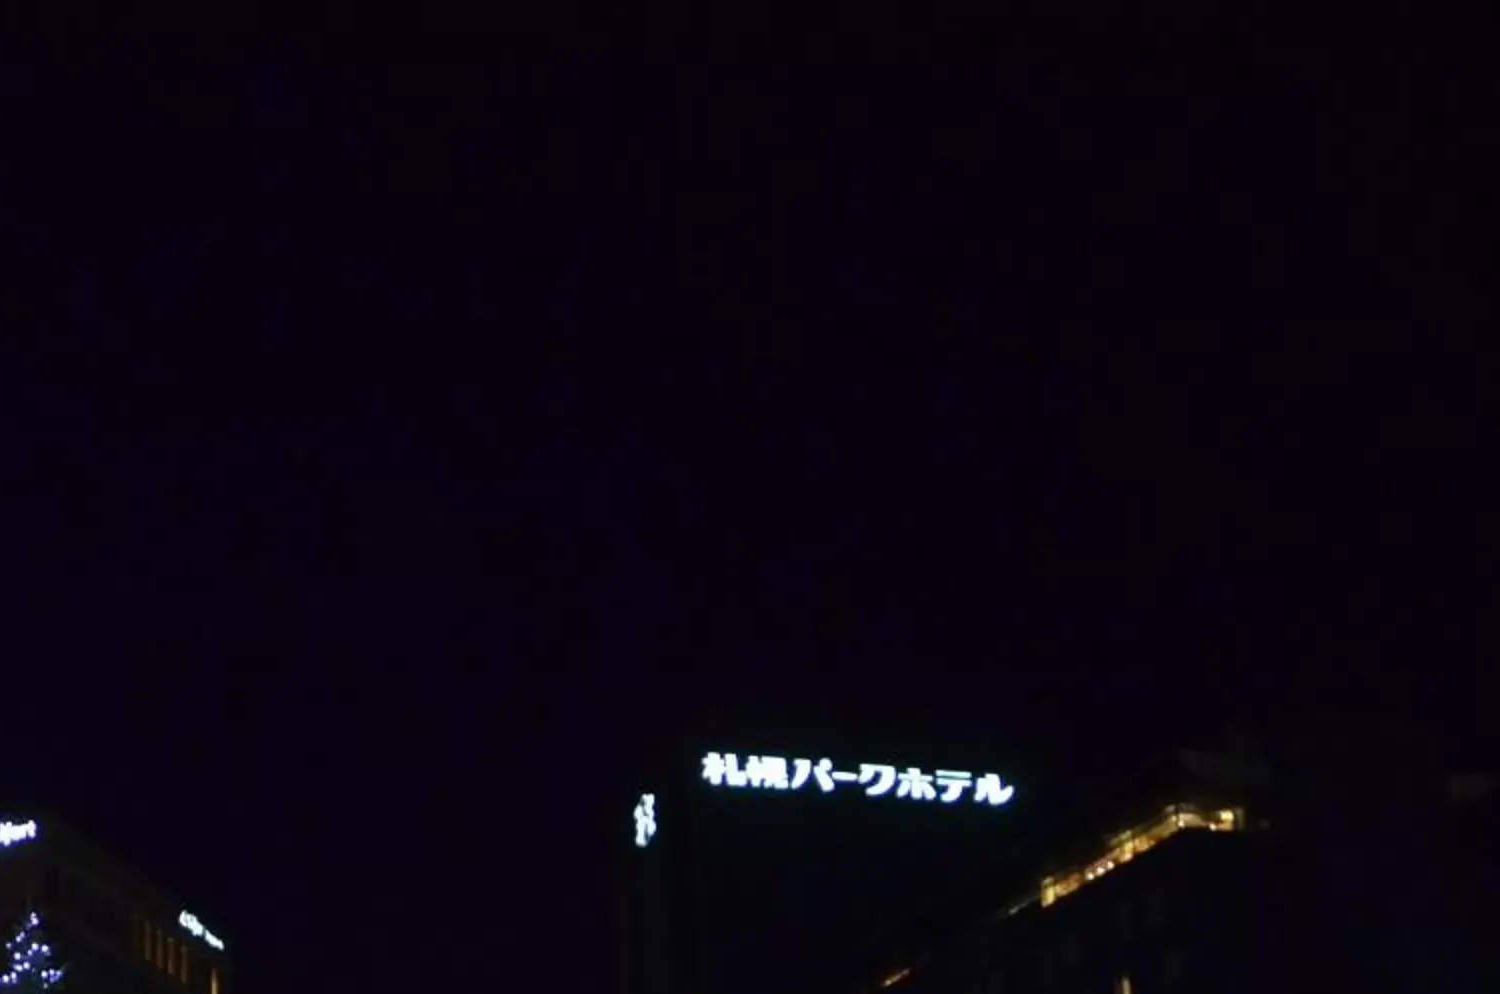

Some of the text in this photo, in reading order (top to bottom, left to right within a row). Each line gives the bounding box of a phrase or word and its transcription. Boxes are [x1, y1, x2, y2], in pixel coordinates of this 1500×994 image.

[701, 751, 1014, 806] 札幌パークホテル
